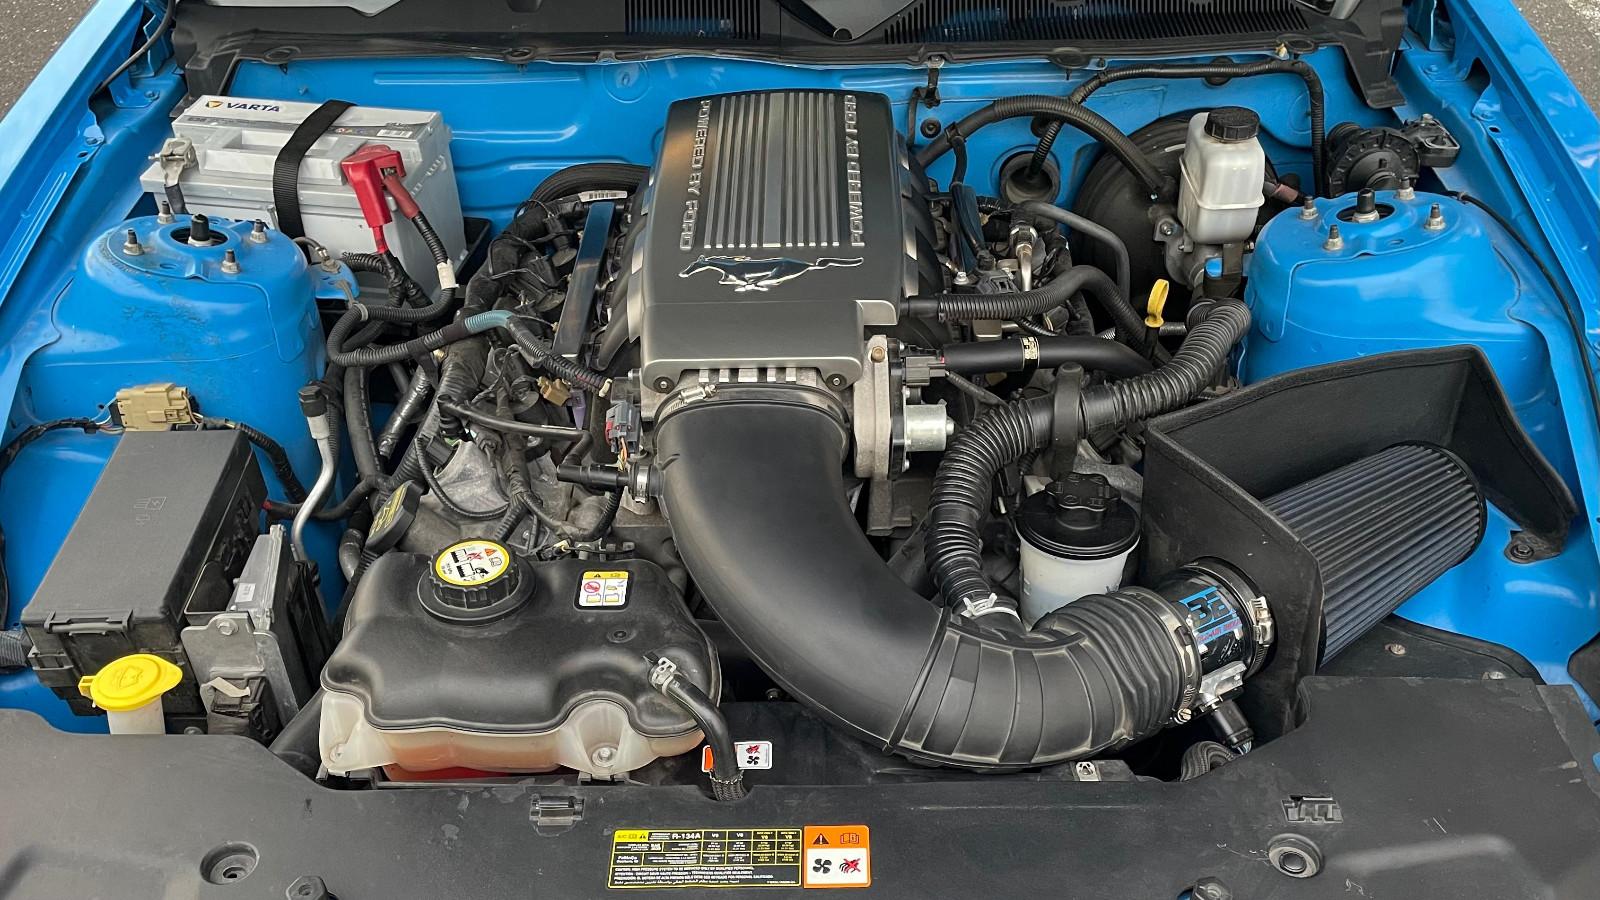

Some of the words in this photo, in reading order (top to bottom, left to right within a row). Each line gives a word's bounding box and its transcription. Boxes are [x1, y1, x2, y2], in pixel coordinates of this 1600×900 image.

[226, 102, 280, 113] VARTA
[844, 94, 858, 133] FORD
[692, 100, 711, 169] POWERED
[846, 136, 860, 157] BY
[687, 172, 702, 197] BY
[847, 161, 865, 247] POWERED
[680, 200, 699, 250] FORD
[671, 832, 701, 840] R-134A
